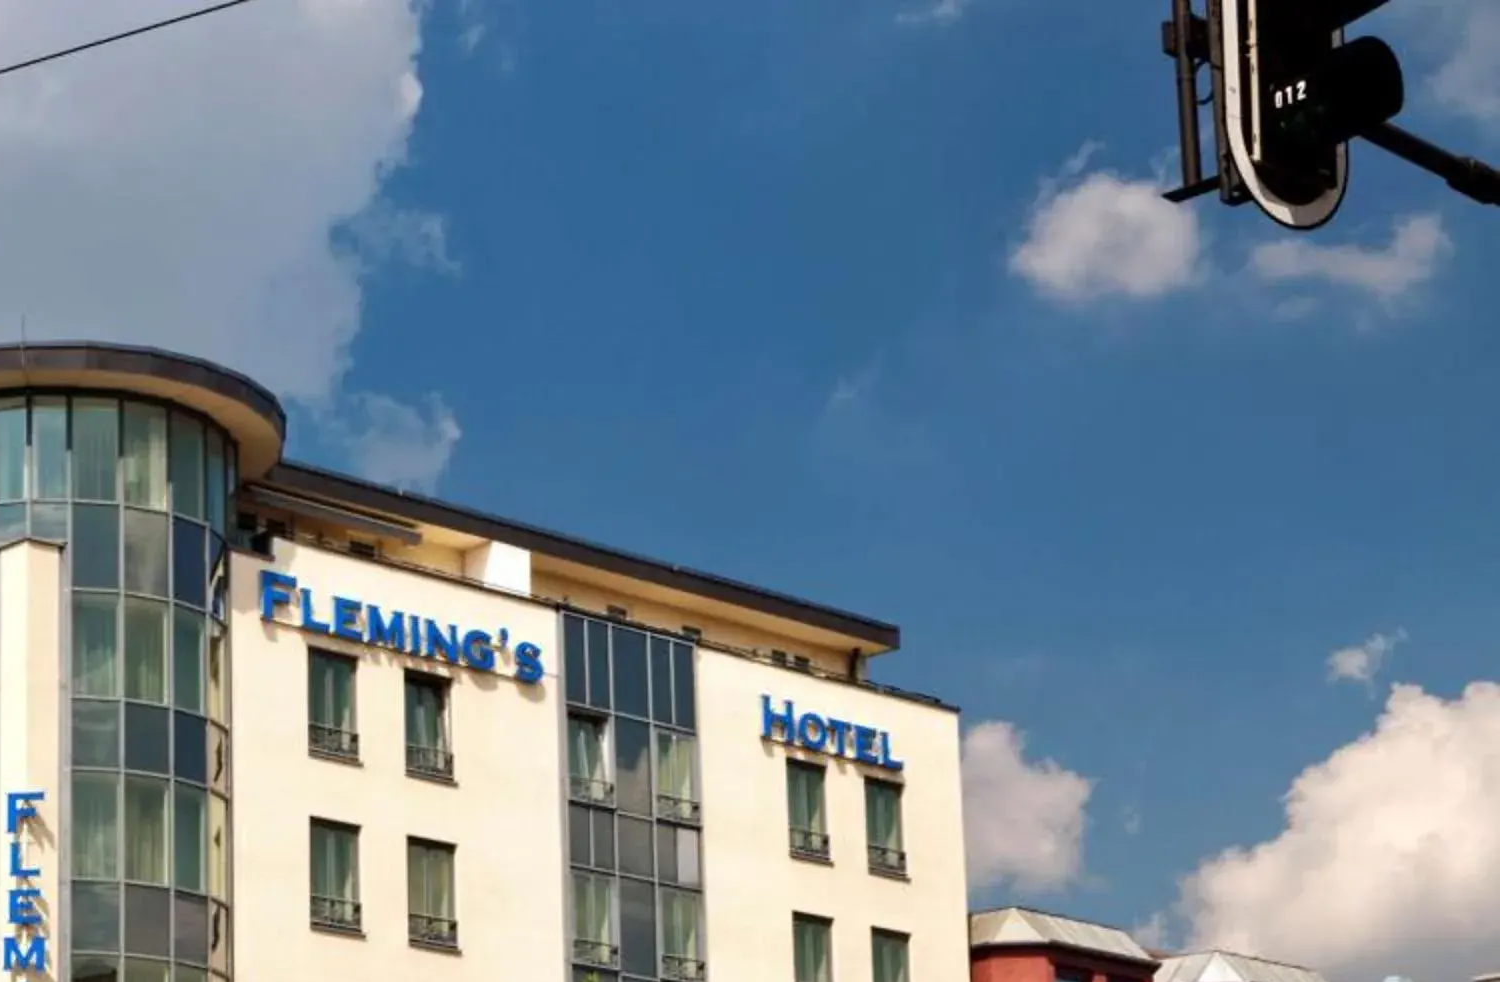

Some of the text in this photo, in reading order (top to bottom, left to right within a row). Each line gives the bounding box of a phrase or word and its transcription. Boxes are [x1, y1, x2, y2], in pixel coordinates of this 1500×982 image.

[1275, 80, 1308, 108] 012
[260, 568, 904, 771] FLEMING'S HOTEL
